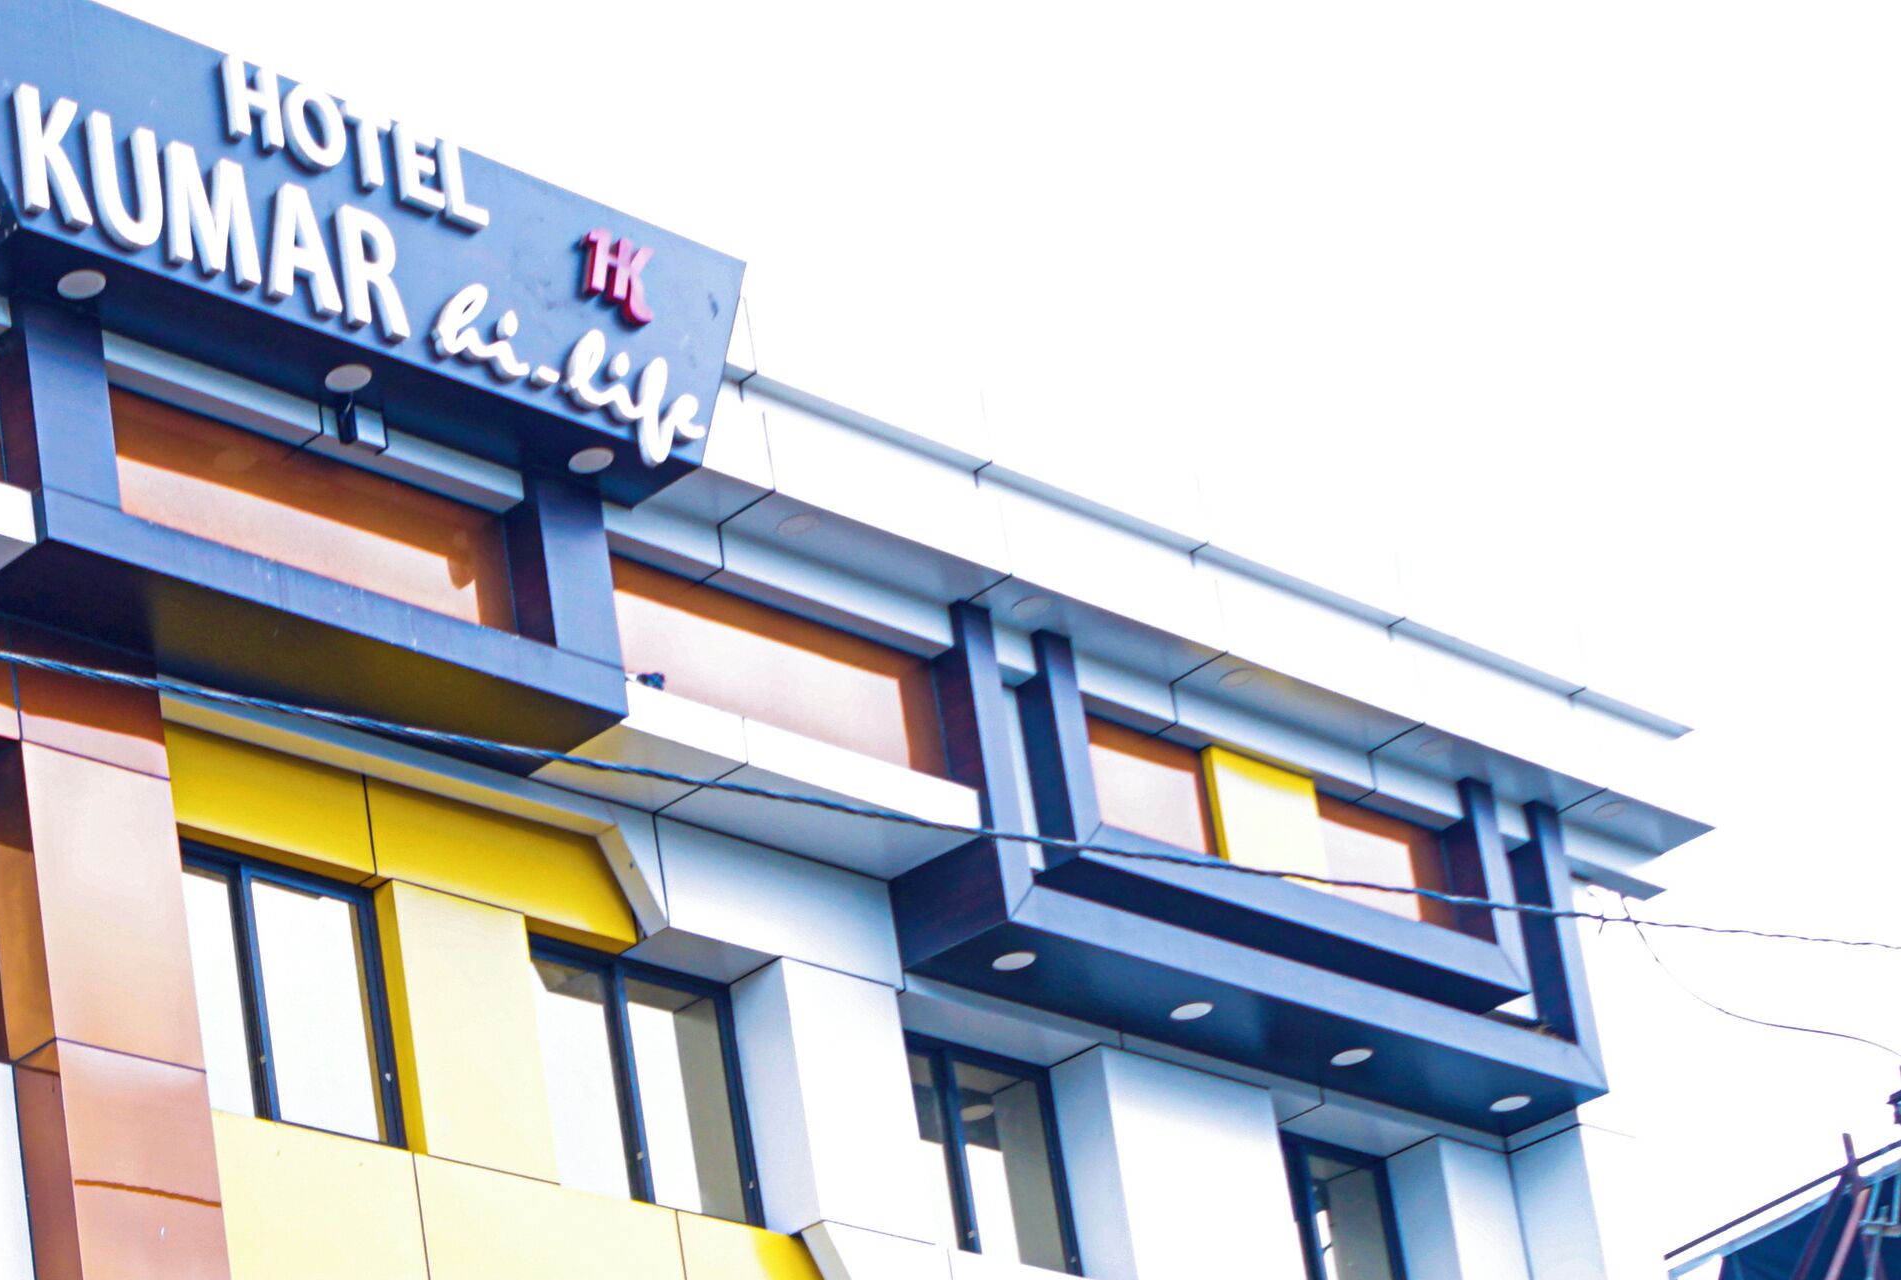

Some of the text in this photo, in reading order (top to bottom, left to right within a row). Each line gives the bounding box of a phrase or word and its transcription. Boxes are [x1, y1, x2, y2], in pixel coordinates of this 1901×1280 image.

[12, 83, 411, 344] KUMAR
[219, 53, 489, 231] HOTEL
[433, 281, 706, 467] hi-life
